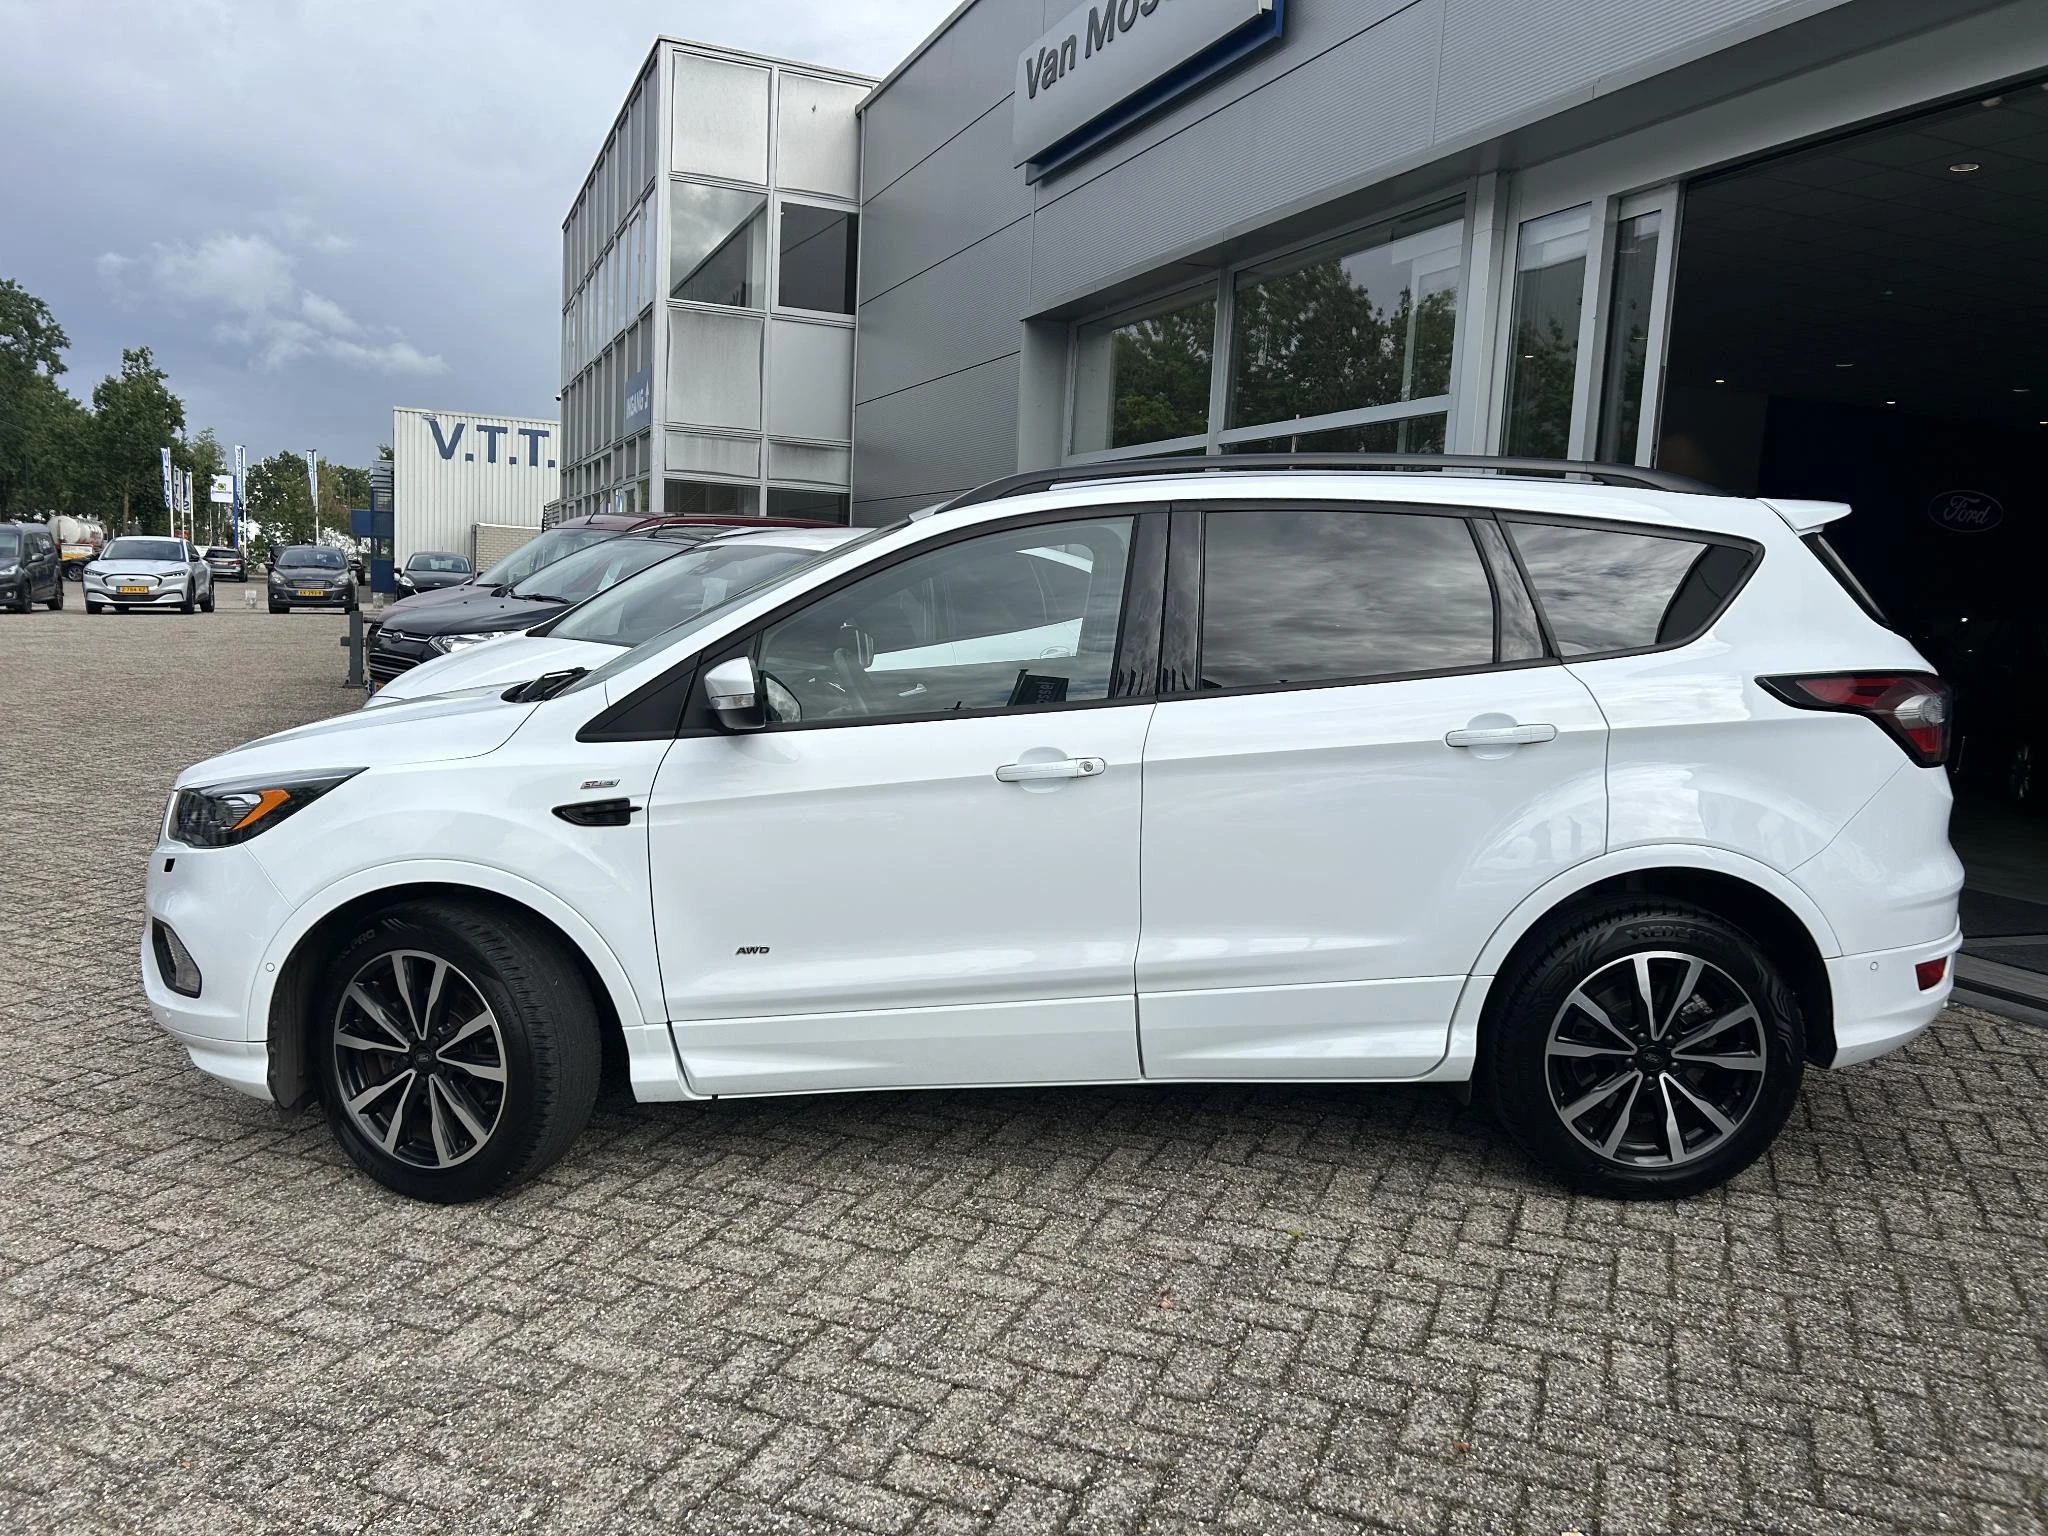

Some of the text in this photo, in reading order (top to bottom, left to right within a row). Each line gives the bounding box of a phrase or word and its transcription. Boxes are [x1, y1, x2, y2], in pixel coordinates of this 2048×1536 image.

[1026, 34, 1077, 99] Van
[1944, 495, 1991, 524] Ford
[735, 946, 770, 955] AWD
